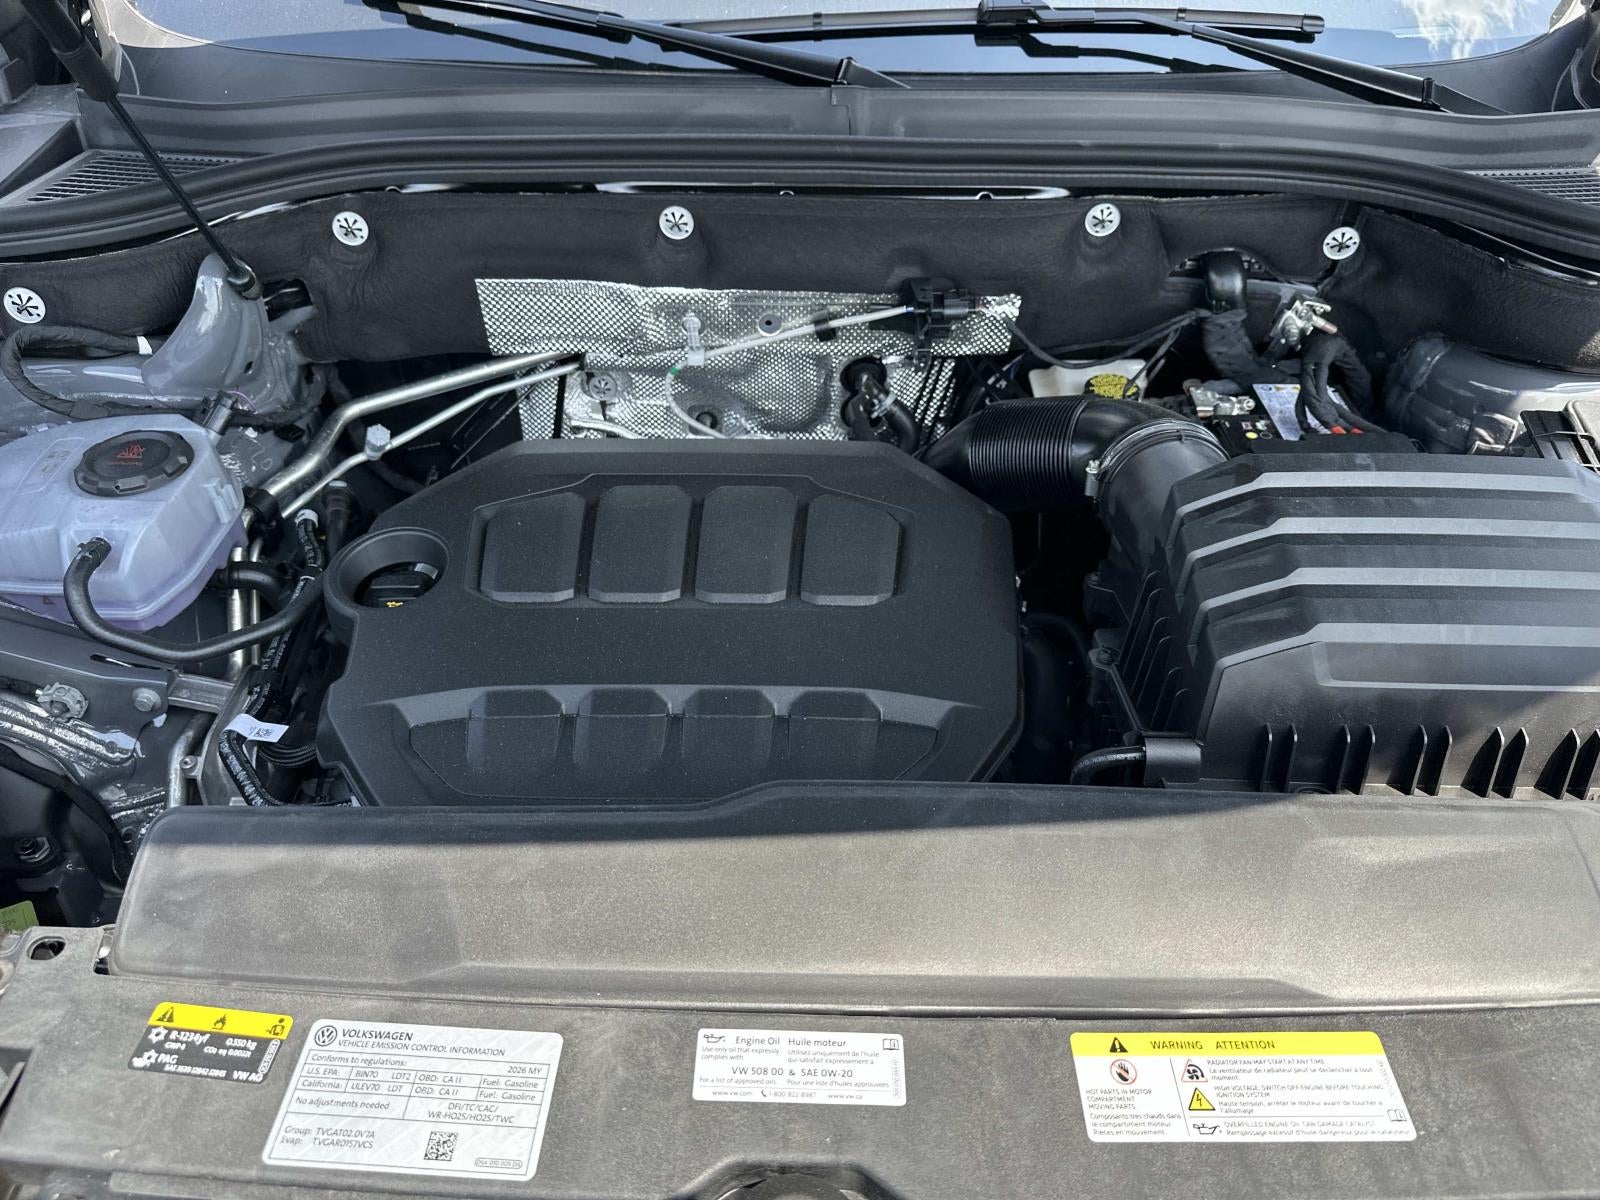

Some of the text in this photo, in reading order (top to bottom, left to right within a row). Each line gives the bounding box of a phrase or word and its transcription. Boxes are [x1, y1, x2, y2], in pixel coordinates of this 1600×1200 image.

[170, 1030, 258, 1050] R-1234yf 0.550 kg
[342, 1028, 413, 1041] VOLKSWAGEN
[736, 1036, 766, 1046] Engine
[767, 1037, 780, 1045] Oil
[788, 1037, 812, 1046] Huile
[1150, 1040, 1276, 1050] WARNING ATTENTION
[338, 1040, 506, 1057] VEHICLE EMISSION CONTROL INFORMATION
[751, 1048, 780, 1056] expressly
[812, 1050, 851, 1058] uniquement
[158, 1053, 178, 1064] PAG
[701, 1053, 729, 1061] complies
[799, 1056, 824, 1064] satisfait
[312, 1054, 543, 1075] Conforms to regulations: 2026 MY
[232, 1070, 248, 1080] VW
[248, 1071, 264, 1082] AG
[731, 1066, 749, 1075] VW
[751, 1067, 769, 1076] 508
[770, 1067, 784, 1076] 00
[801, 1068, 818, 1077] SAE
[821, 1068, 853, 1078] 0W-20
[307, 1067, 321, 1075] U.S.
[323, 1068, 340, 1077] EPA:
[355, 1070, 379, 1079] BIN70
[391, 1072, 411, 1081] LDT2
[418, 1073, 439, 1082] OBD:
[442, 1075, 454, 1083] CA
[482, 1078, 501, 1087] Fuel:
[504, 1079, 539, 1089] Gasoline
[734, 1078, 765, 1086] approved
[302, 1078, 343, 1089] California:
[351, 1082, 380, 1092] ULEV70
[387, 1085, 403, 1093] LDT
[415, 1086, 434, 1095] OBD:
[438, 1088, 451, 1096] CA
[479, 1090, 498, 1099] Fuel:
[501, 1092, 536, 1101] Gasoline
[296, 1097, 390, 1110] No adjustments needed
[448, 1102, 499, 1113] DFI/TC/CAC/
[285, 1125, 313, 1135] Group:
[281, 1135, 304, 1145] Evap:
